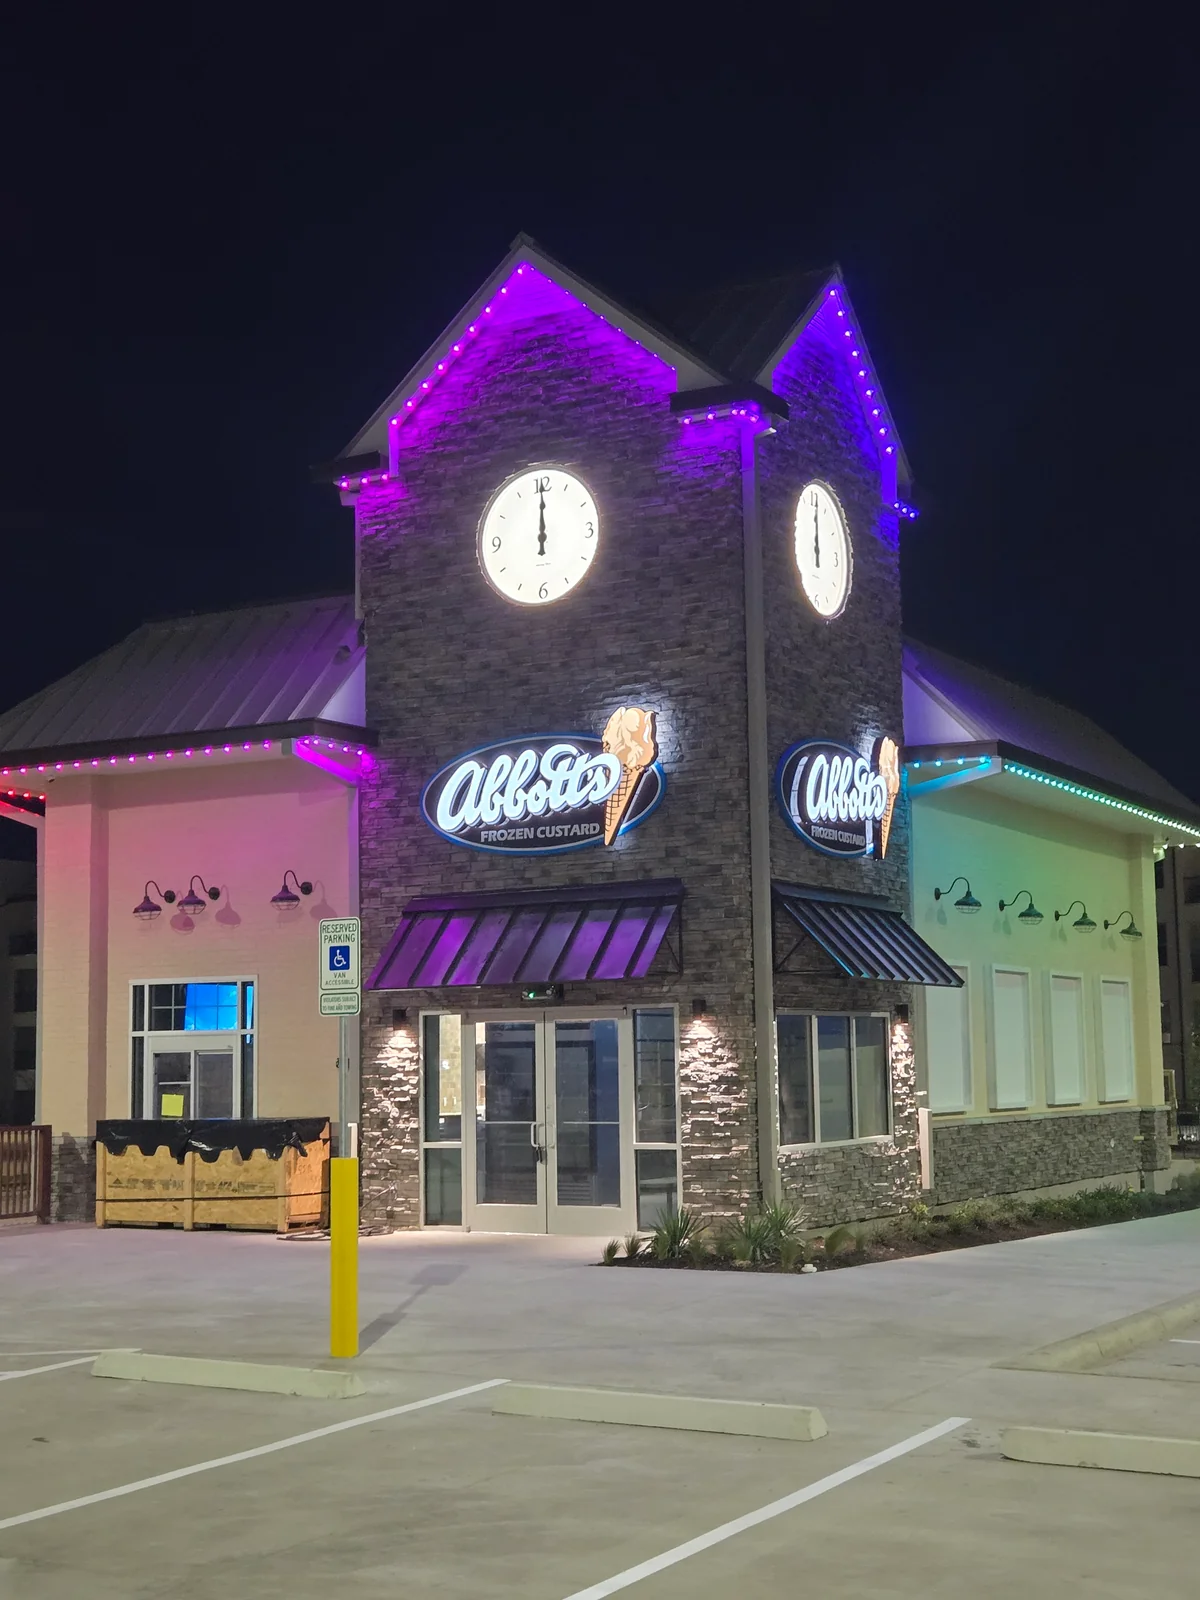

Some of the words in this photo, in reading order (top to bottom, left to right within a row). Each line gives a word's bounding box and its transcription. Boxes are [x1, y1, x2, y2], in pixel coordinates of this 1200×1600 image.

[534, 476, 552, 494] 12
[585, 522, 594, 538] 3
[492, 536, 502, 553] 9
[539, 582, 548, 599] 6
[480, 826, 534, 843] FROZEN
[536, 822, 600, 839] CUSTARD
[811, 825, 837, 841] FROZEN
[838, 830, 866, 846] CUSTARD
[322, 923, 356, 933] RESERVED
[324, 933, 355, 943] PARKING
